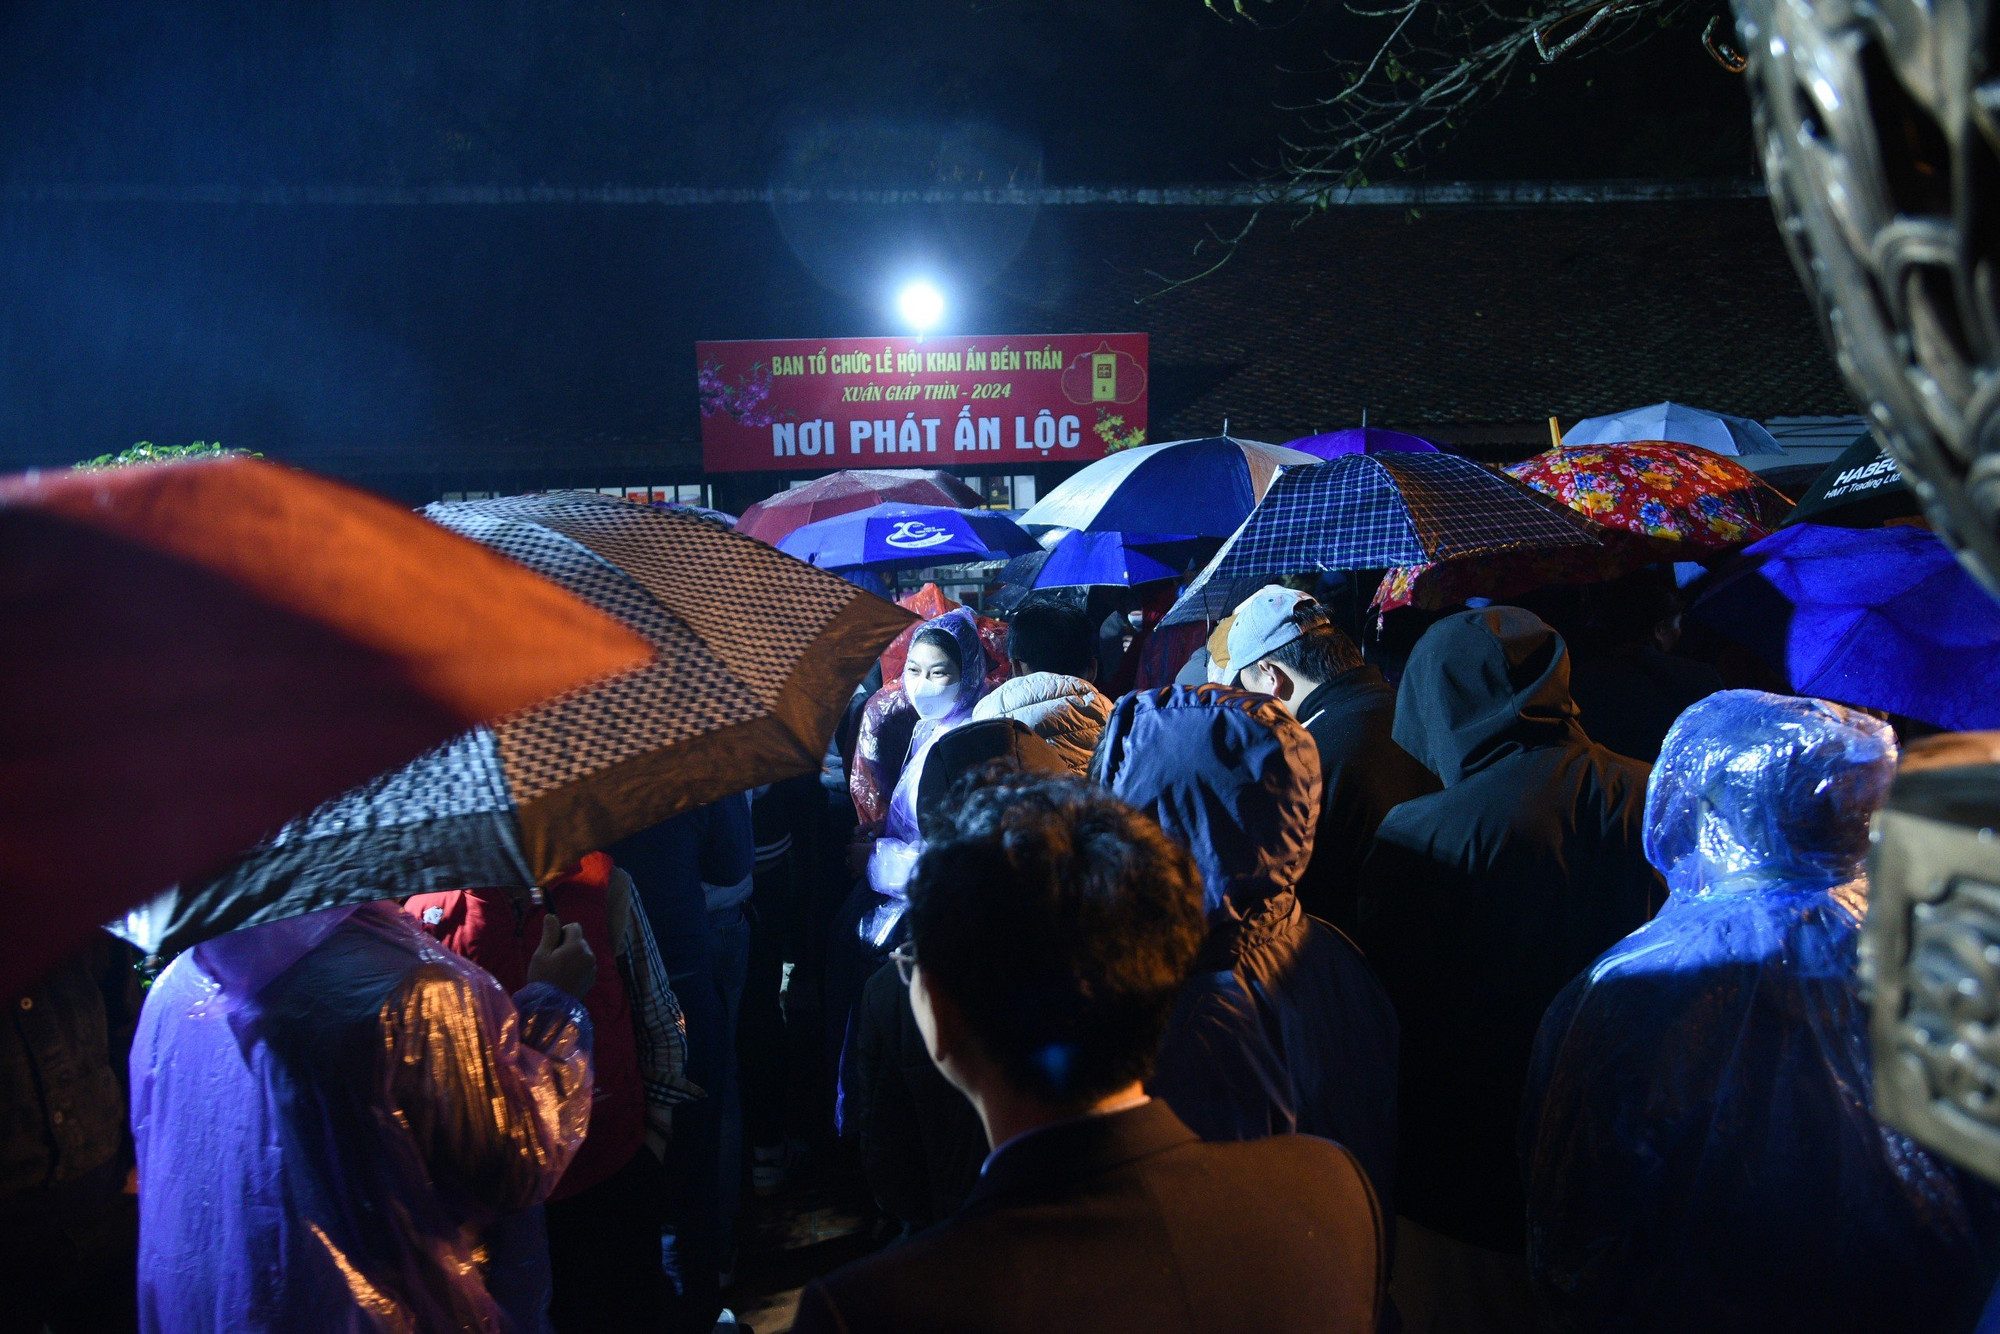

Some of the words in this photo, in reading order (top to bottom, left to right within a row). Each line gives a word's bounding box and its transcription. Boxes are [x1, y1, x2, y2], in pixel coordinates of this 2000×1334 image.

[773, 356, 804, 375] BAN
[808, 347, 827, 375] TỔ
[831, 350, 871, 374] CHỨC
[876, 346, 893, 373] LỄ
[897, 349, 923, 377] HỘI
[926, 352, 961, 372] KHAI
[965, 345, 986, 371] ẤN
[990, 344, 1020, 370] ĐỀN
[1024, 344, 1062, 370] TRẦN
[842, 382, 884, 402] XUÂN
[885, 381, 921, 401] GIÁP
[924, 380, 960, 400] THÌN
[971, 383, 1012, 399] 2024
[772, 419, 835, 456] NƠI
[849, 412, 941, 454] PHÁT
[954, 404, 1001, 450] ẤN
[1015, 408, 1080, 456] LỘC
[1823, 485, 1849, 500] HMT
[1848, 478, 1883, 493] Trading
